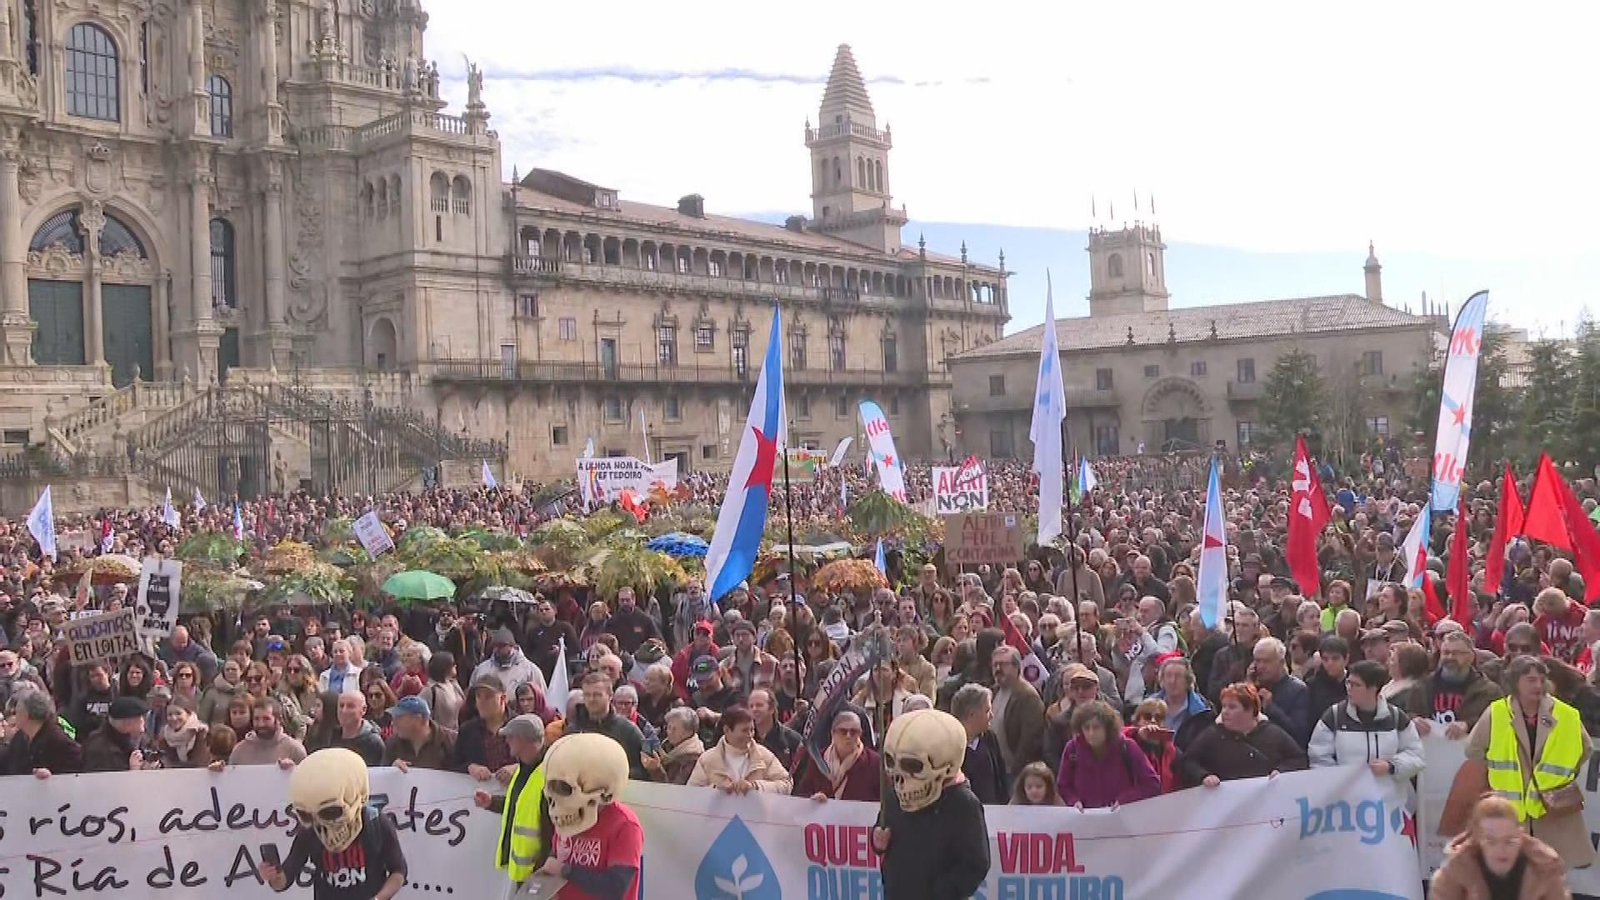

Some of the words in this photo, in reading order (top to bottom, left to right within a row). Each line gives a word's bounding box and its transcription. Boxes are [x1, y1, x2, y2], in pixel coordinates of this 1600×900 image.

[938, 491, 984, 511] NON
[143, 618, 170, 631] NON
[29, 802, 136, 844] ríos,
[158, 786, 299, 838] adeus
[570, 851, 600, 868] NON
[997, 831, 1086, 874] VIDA.
[26, 854, 130, 898] Ría
[146, 844, 208, 888] de
[323, 865, 368, 889] NON
